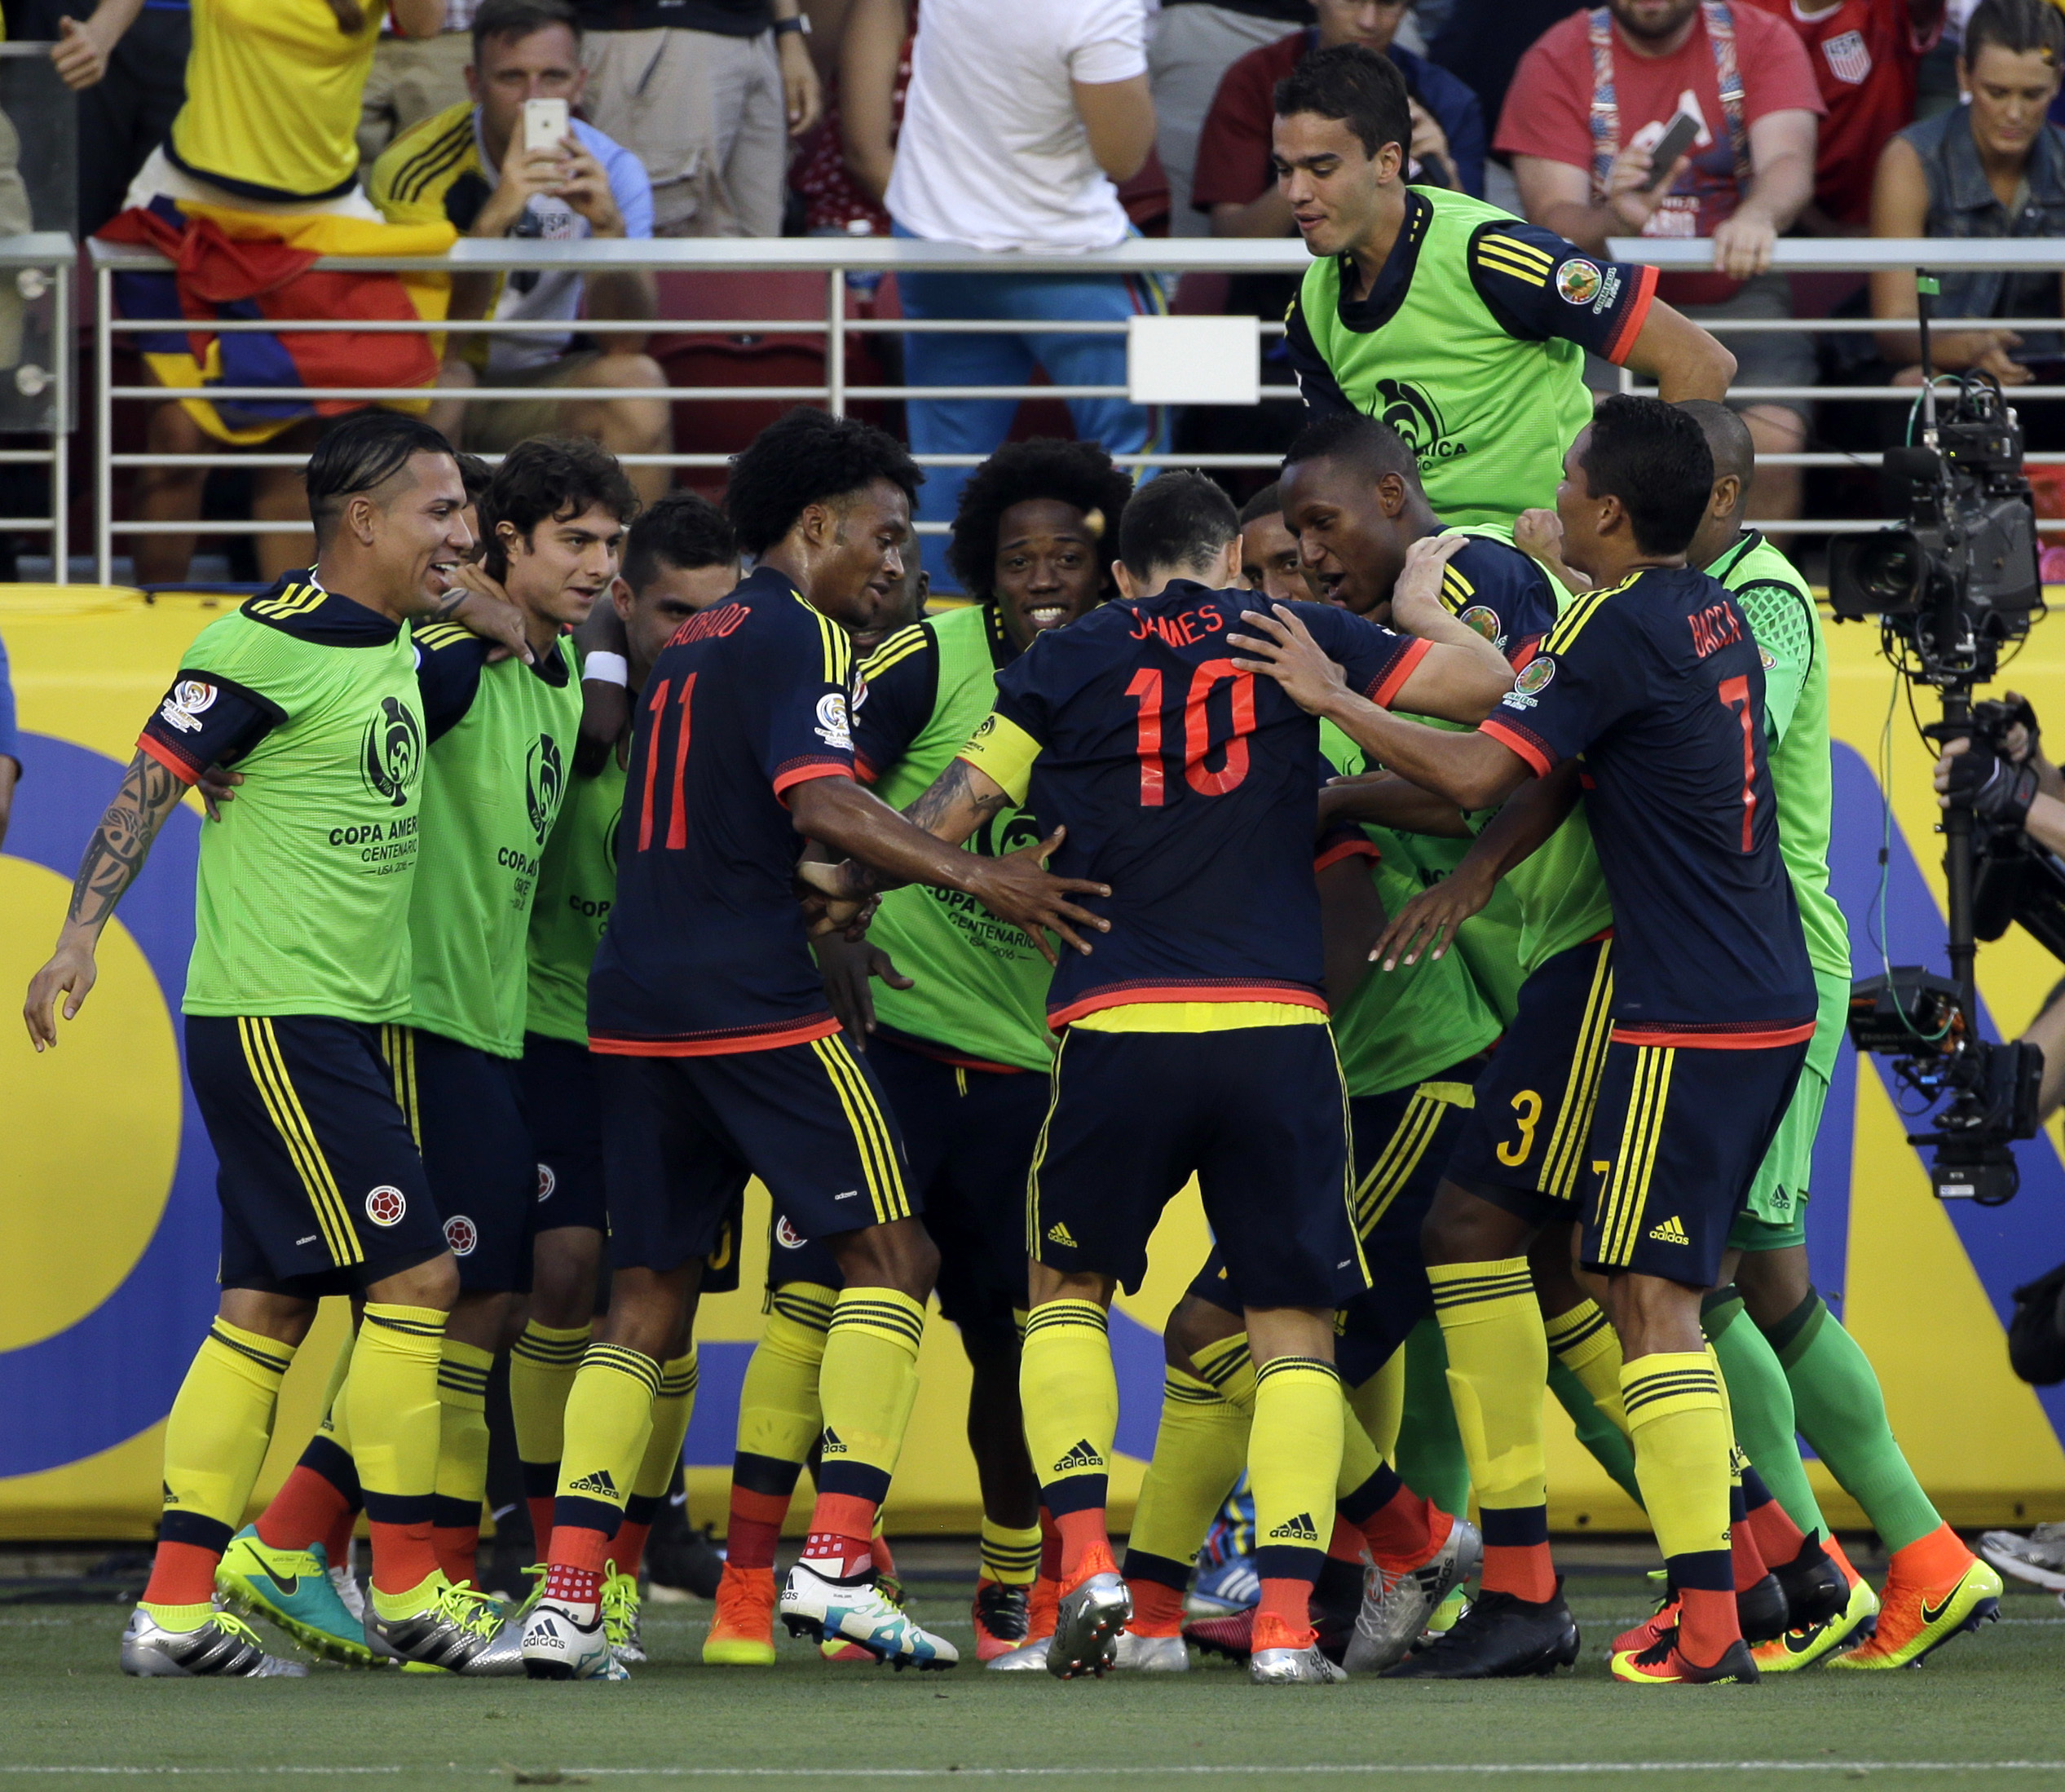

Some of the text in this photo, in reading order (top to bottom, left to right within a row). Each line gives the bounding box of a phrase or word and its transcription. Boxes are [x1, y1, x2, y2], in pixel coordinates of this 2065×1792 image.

[1130, 605, 1224, 647] JAMES
[1688, 601, 1742, 658] BACCA
[1124, 657, 1256, 806] 10
[638, 671, 697, 853] 11
[1718, 674, 1757, 853] 7
[329, 823, 383, 846] COPA
[927, 886, 976, 914] OPA
[948, 911, 1036, 949] CENTENARIO
[993, 946, 1015, 960] 2016
[1496, 1089, 1542, 1167] 3
[1592, 1160, 1610, 1226] 7
[1048, 1233, 1078, 1248] adidas
[1649, 1229, 1689, 1246] adidas
[1053, 1456, 1103, 1472] adidas
[569, 1481, 620, 1499] adidas
[1269, 1529, 1318, 1542] adidas
[523, 1634, 566, 1649] adidas
